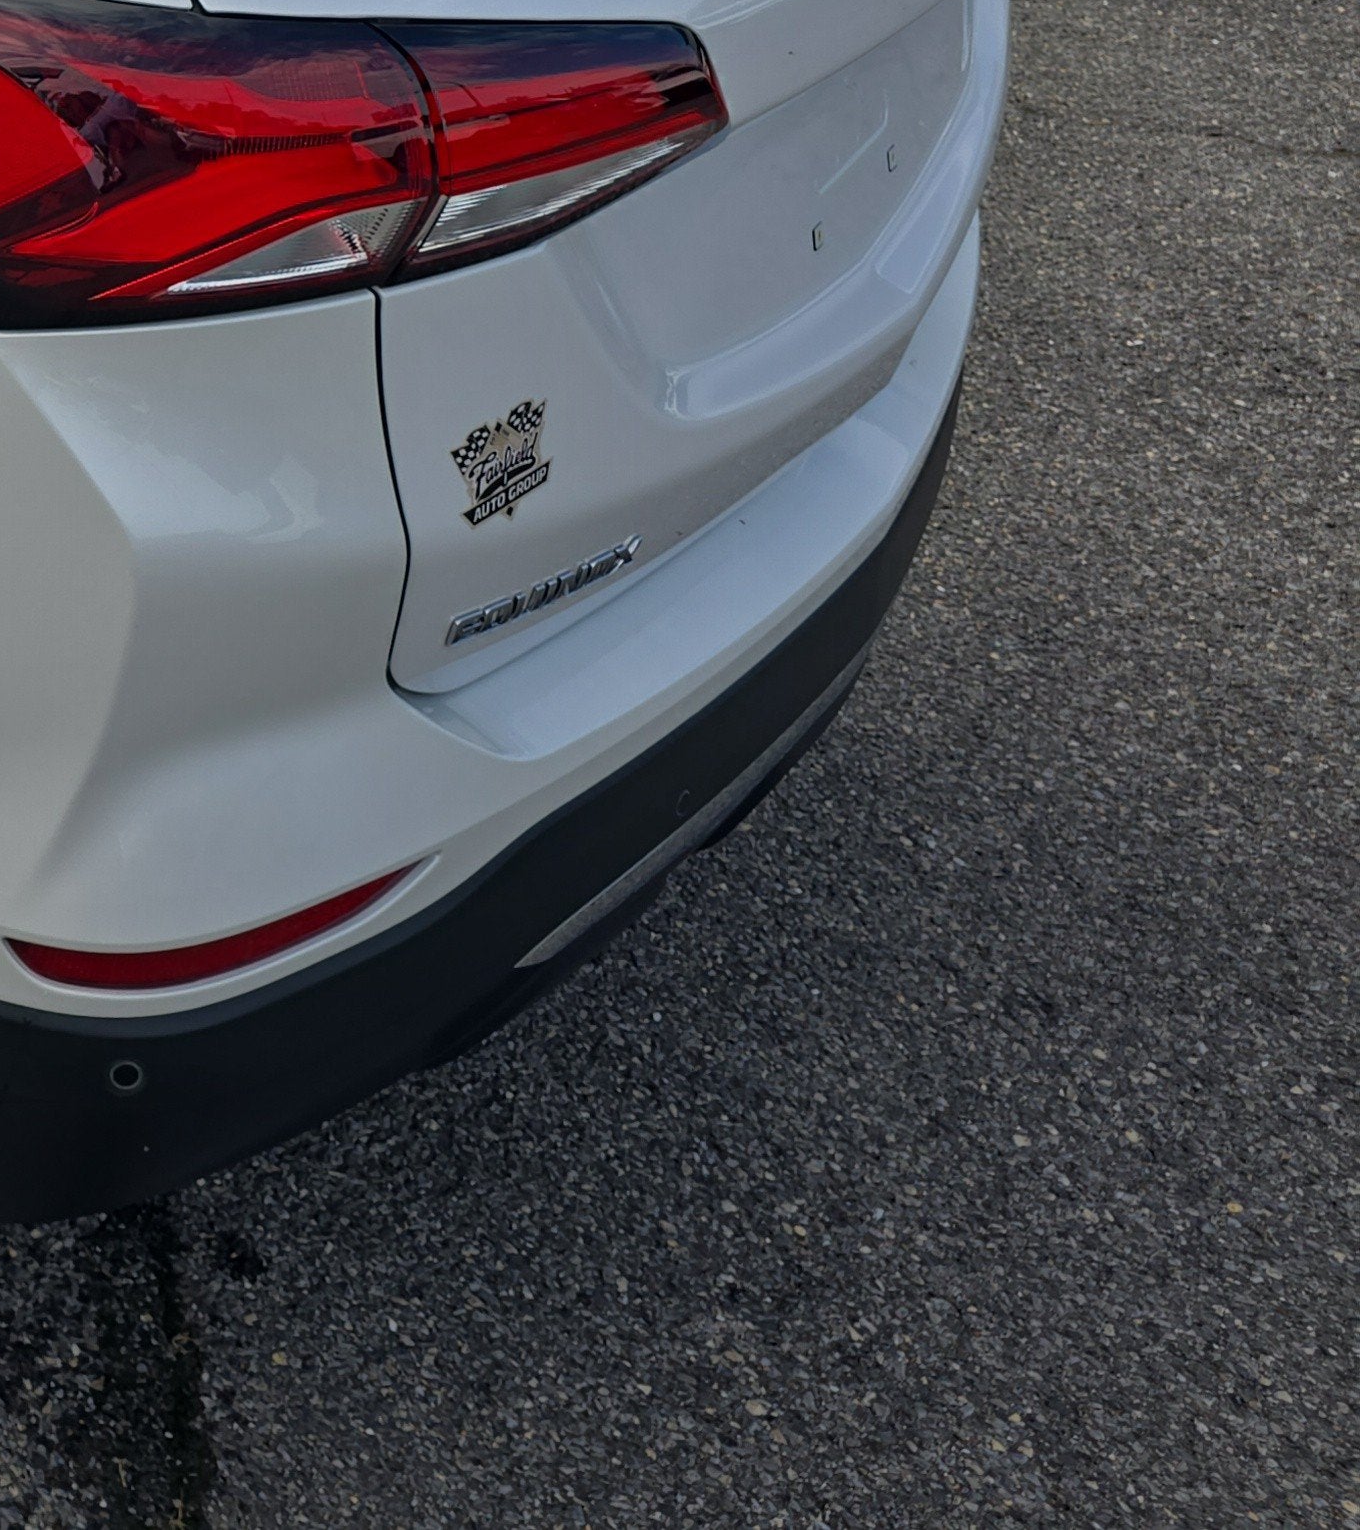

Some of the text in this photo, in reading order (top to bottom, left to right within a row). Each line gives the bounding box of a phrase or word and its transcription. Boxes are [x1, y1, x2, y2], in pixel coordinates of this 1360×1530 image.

[467, 432, 538, 502] Fairfield
[473, 466, 548, 523] AUTO GROUP
[445, 533, 643, 647] EQUINOX
